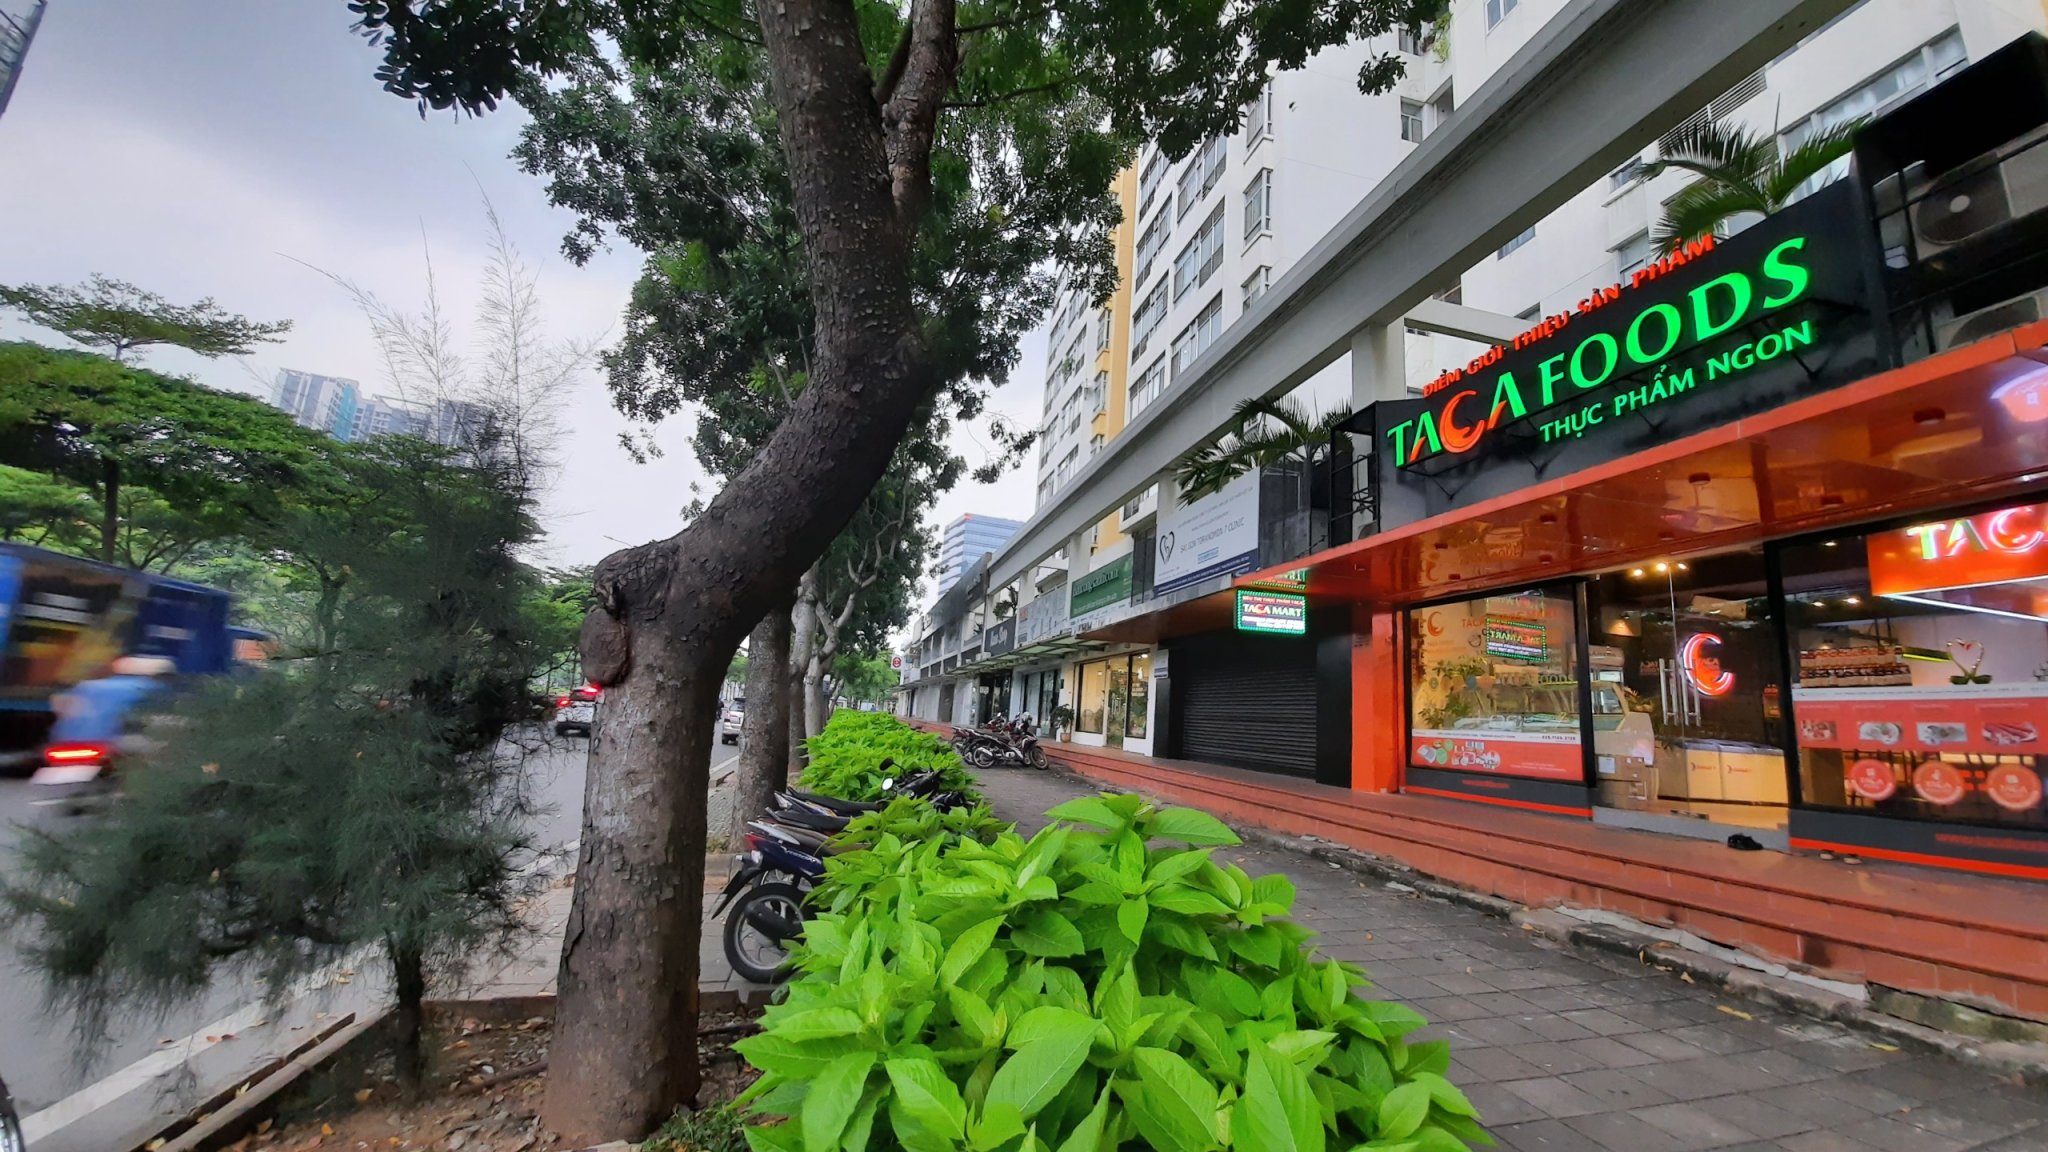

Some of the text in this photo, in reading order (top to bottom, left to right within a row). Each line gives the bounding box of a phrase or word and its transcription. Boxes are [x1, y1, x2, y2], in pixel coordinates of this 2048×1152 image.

[1387, 237, 1808, 467] TACA FOODS
[1513, 310, 1571, 351] THIỆU
[1577, 283, 1621, 313] SẢN
[1540, 320, 1811, 442] THỰC PHẨM NGON
[1243, 603, 1303, 617] TACA MART
